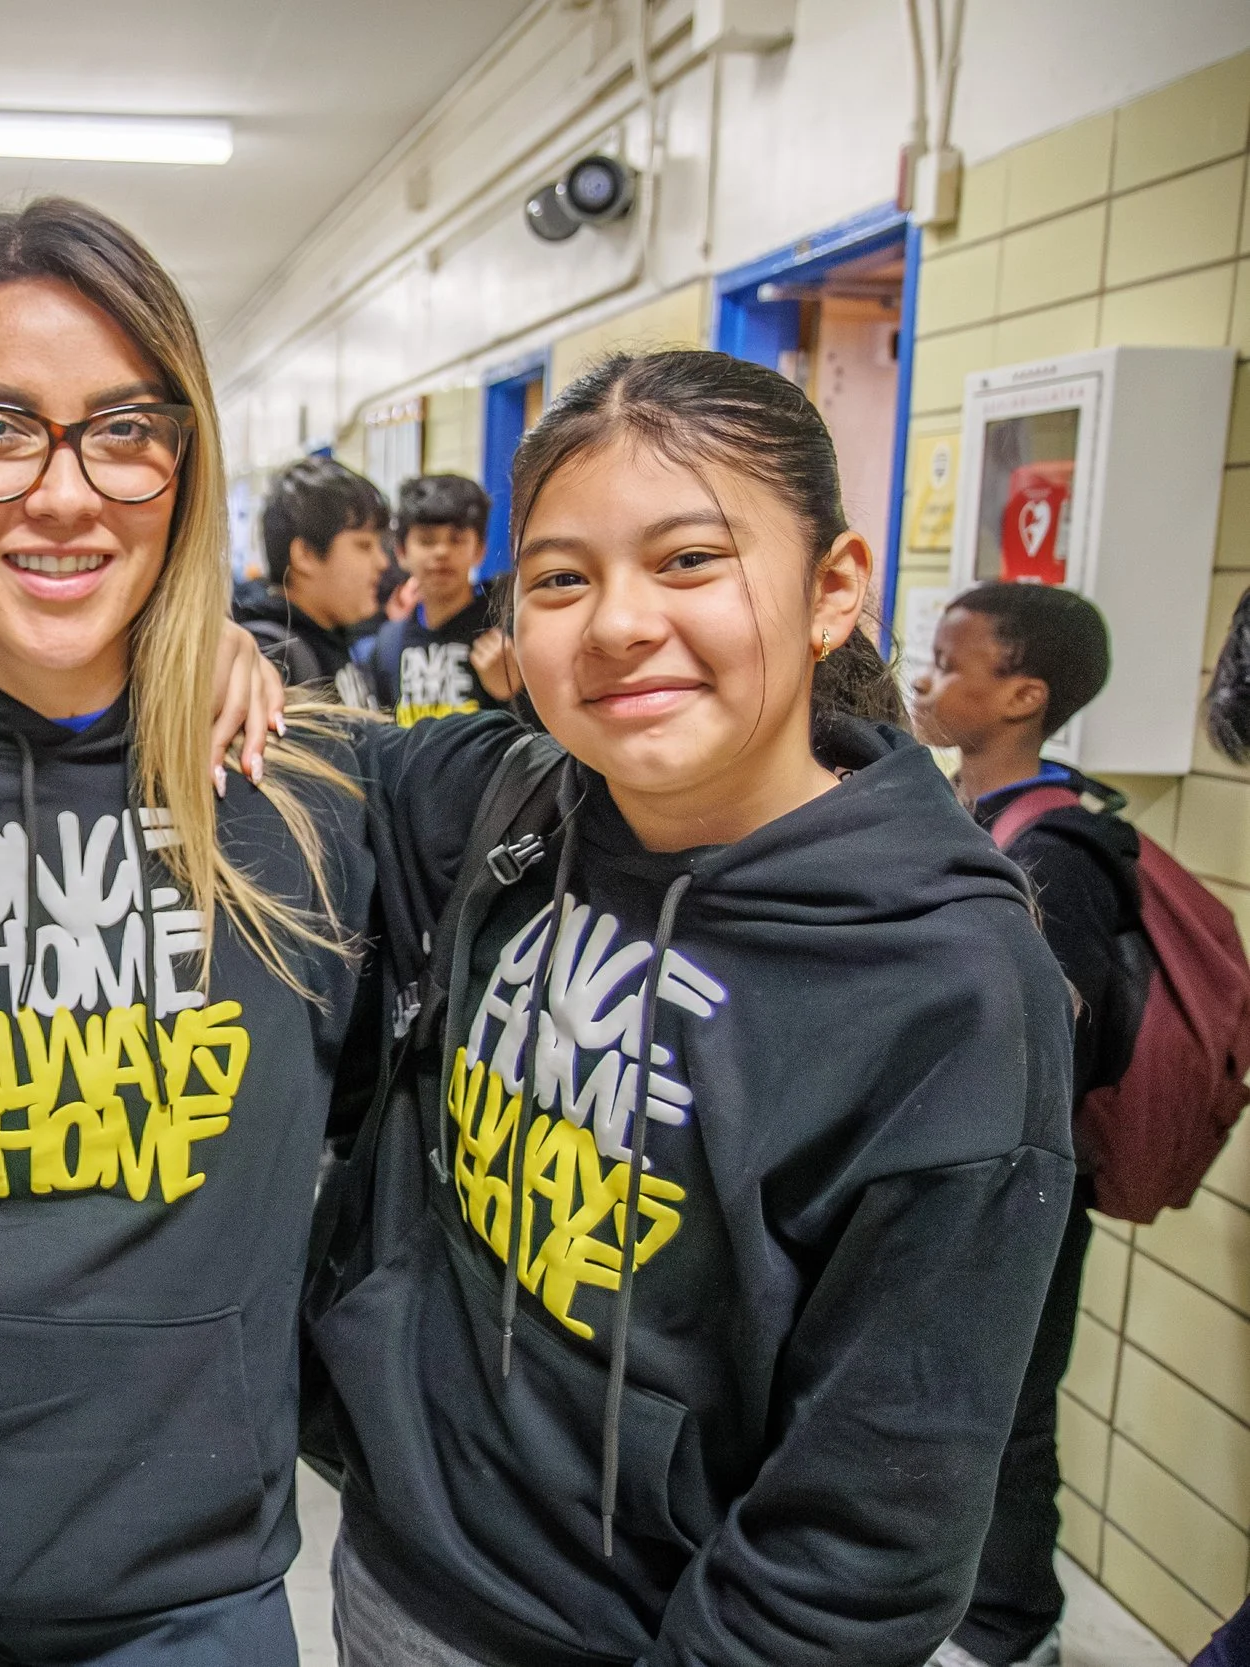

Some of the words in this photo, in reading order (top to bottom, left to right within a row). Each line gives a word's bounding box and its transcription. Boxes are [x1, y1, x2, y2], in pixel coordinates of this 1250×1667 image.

[466, 963, 692, 1169] HOME
[500, 894, 729, 1066] ONCE
[448, 1047, 686, 1272] ALWAYS
